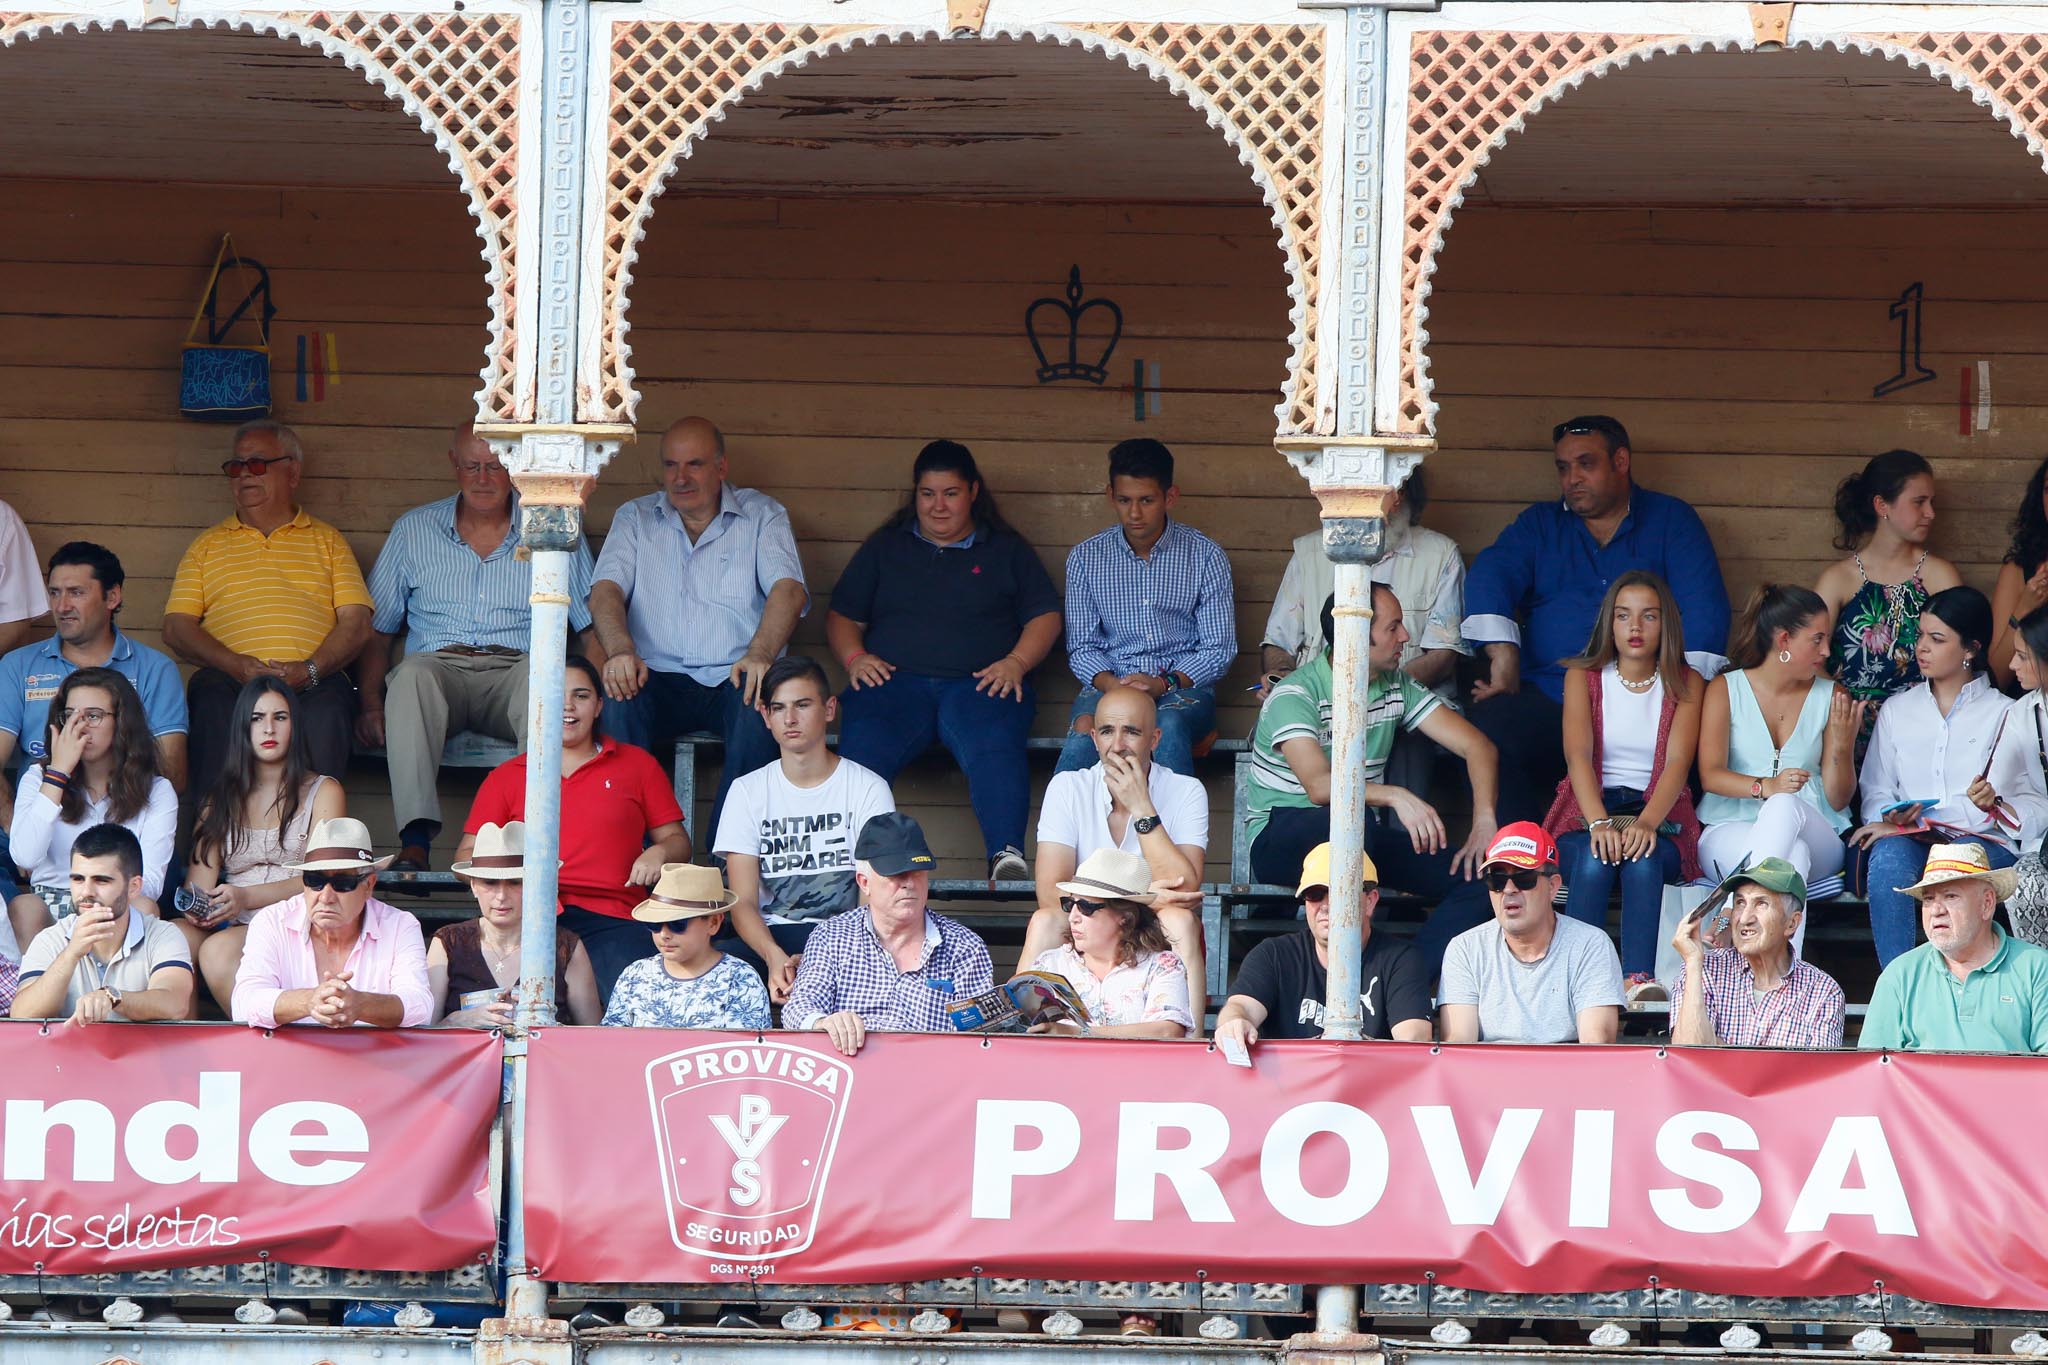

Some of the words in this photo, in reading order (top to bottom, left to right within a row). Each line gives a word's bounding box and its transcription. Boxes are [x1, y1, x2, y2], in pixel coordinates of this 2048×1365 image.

[760, 812, 843, 837] CNTMP
[760, 834, 811, 855] DNM
[669, 1049, 839, 1094] PROVISA
[3, 1071, 370, 1186] nde
[971, 1099, 1919, 1238] PROVISA
[80, 1202, 241, 1250] selectas
[685, 1222, 801, 1246] SEGURIDAD
[710, 1263, 733, 1274] DGS
